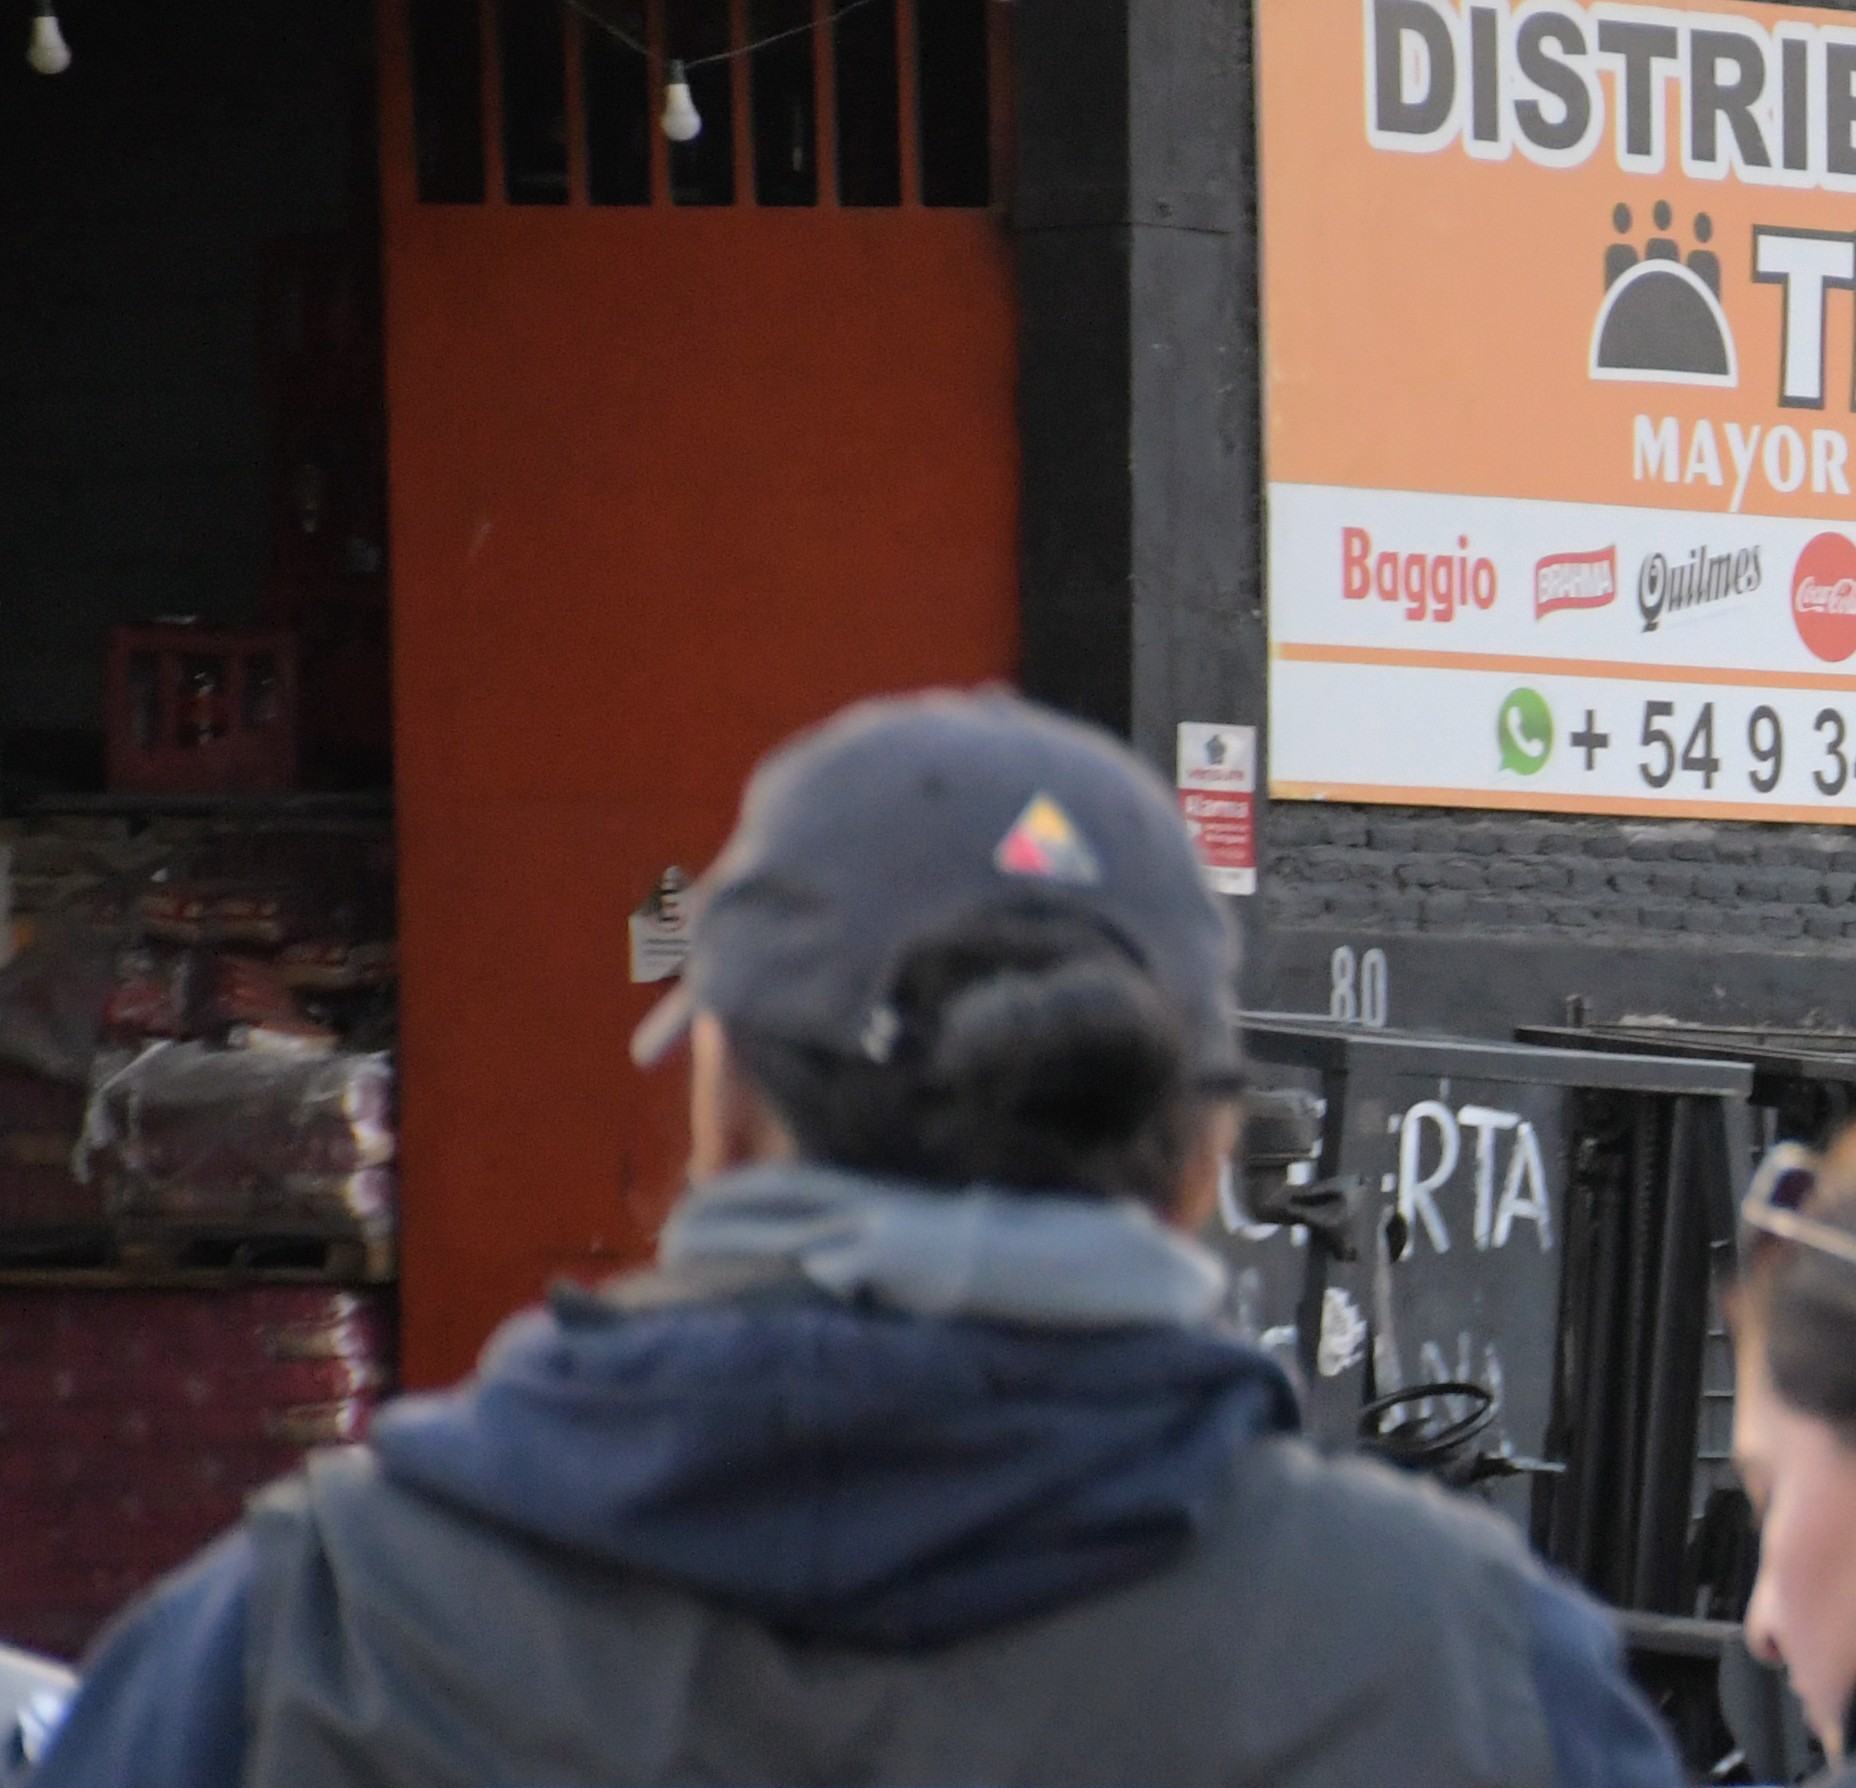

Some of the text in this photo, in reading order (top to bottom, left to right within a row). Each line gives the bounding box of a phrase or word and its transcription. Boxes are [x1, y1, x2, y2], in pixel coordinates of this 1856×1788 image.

[1632, 414, 1852, 513] MAYOR
[1341, 526, 1498, 623] Baggio
[1637, 544, 1764, 633] Quilmes
[1639, 699, 1720, 791] 54
[1747, 704, 1784, 795] 9
[1331, 945, 1389, 1028] 80
